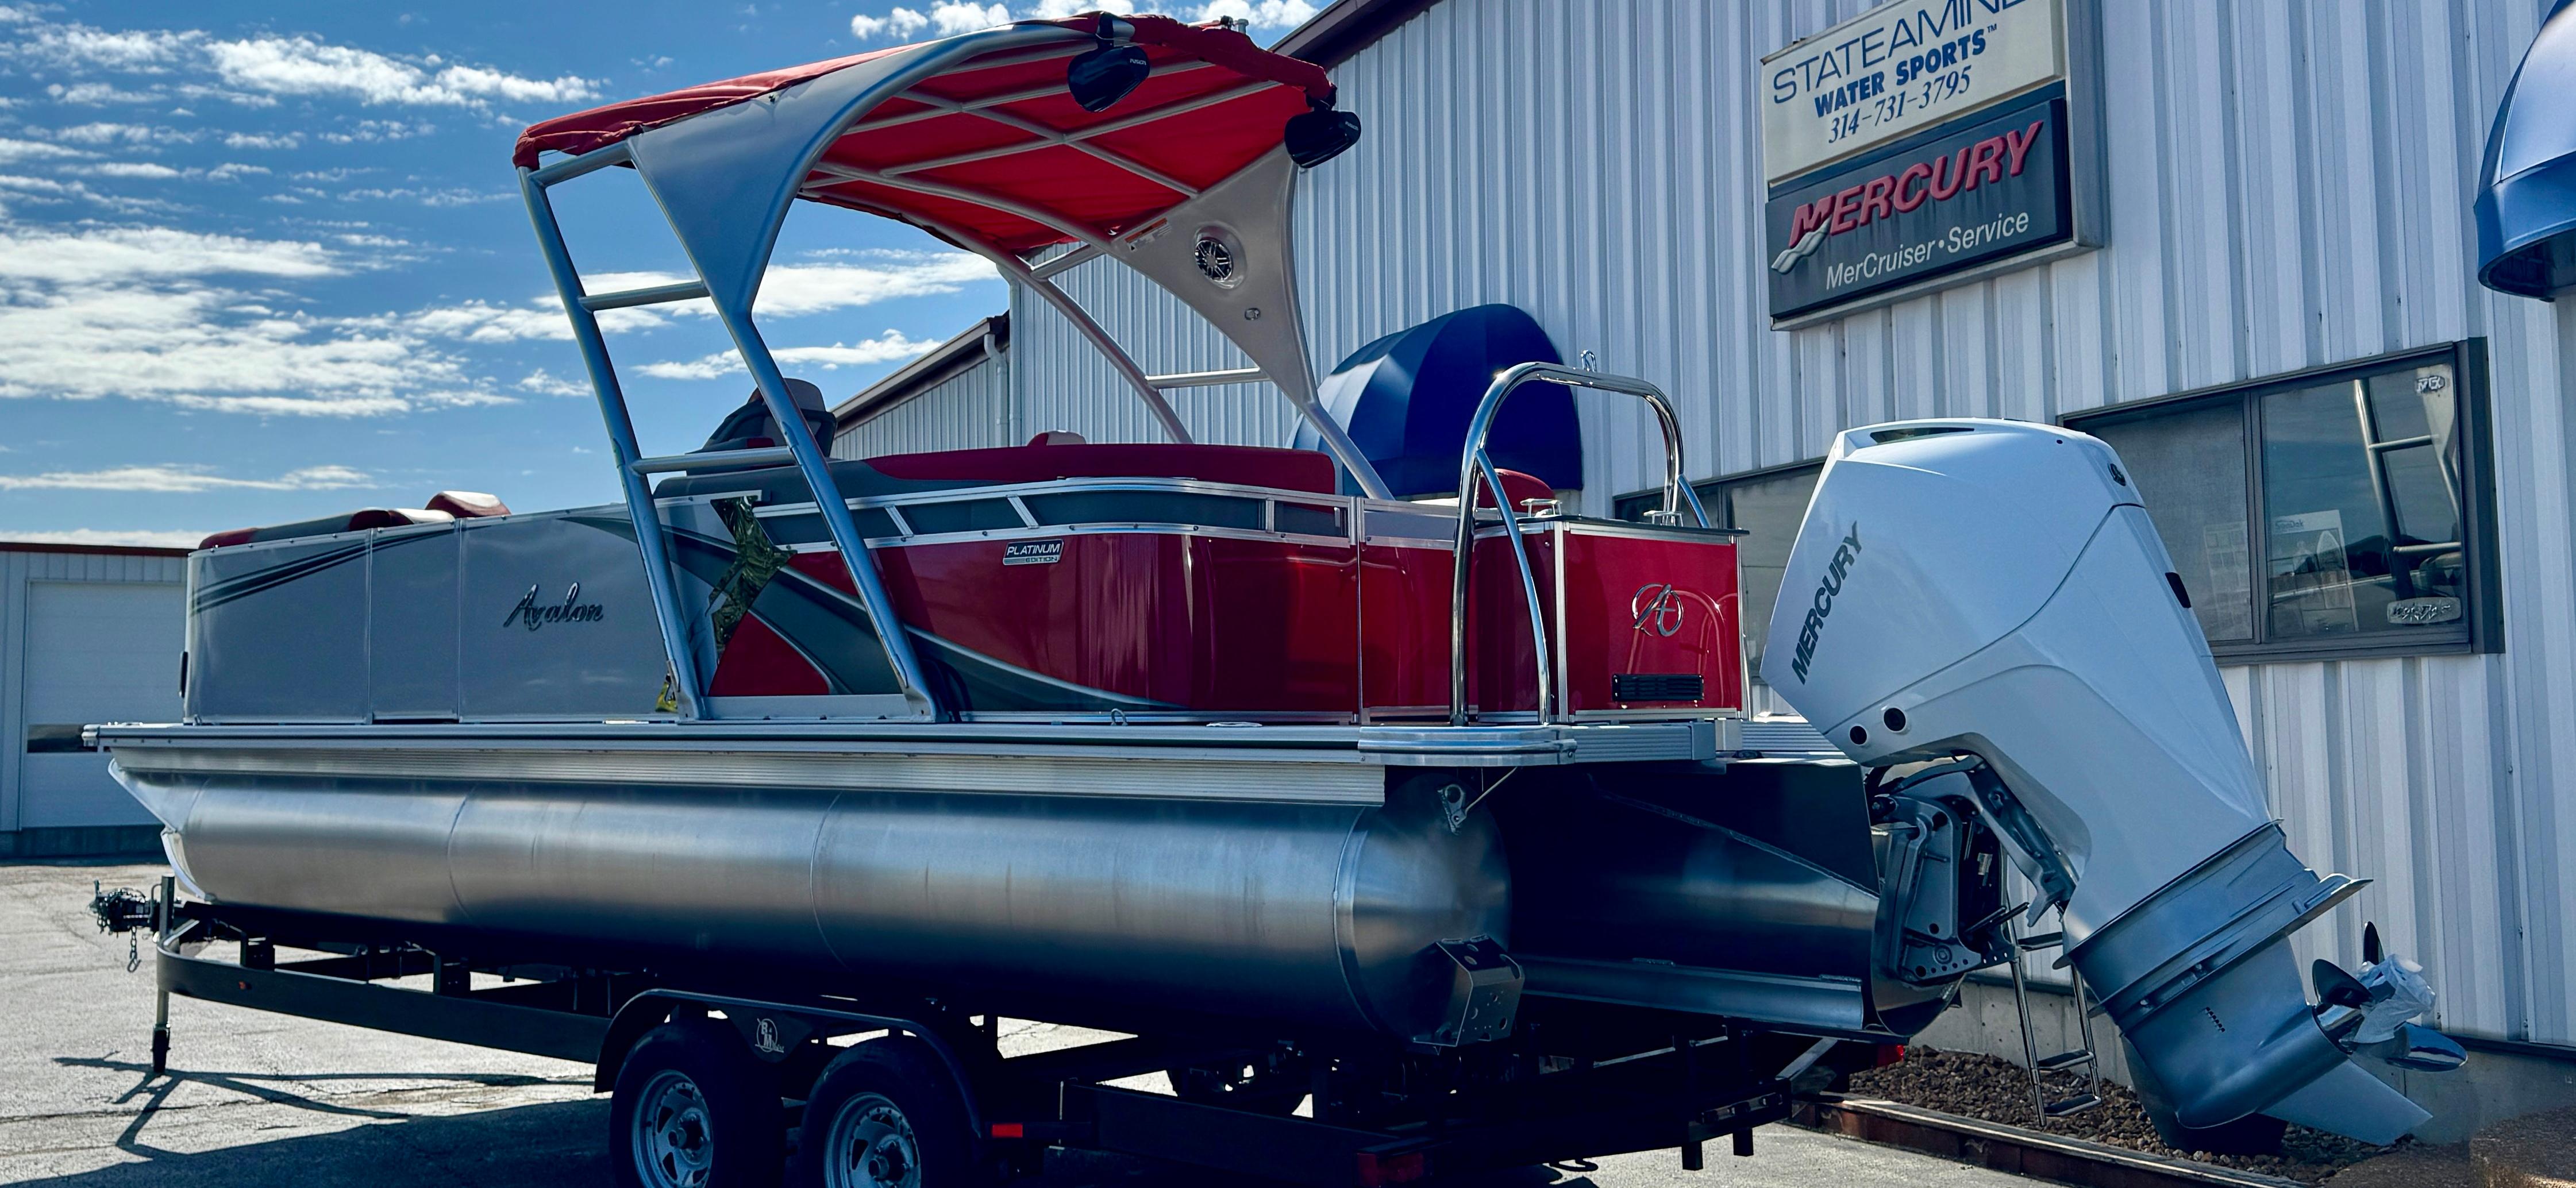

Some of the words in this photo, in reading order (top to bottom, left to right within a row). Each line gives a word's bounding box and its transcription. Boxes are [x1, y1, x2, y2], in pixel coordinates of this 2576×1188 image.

[1773, 0, 2026, 104] STATEAMIN
[1814, 71, 1885, 118] WATER
[1828, 65, 1972, 144] 314-731-3795
[1789, 120, 2044, 249] MERCURY
[1007, 543, 1061, 557] PLATINUM
[503, 582, 603, 631] Avalon
[1791, 520, 1862, 685] MERCURY
